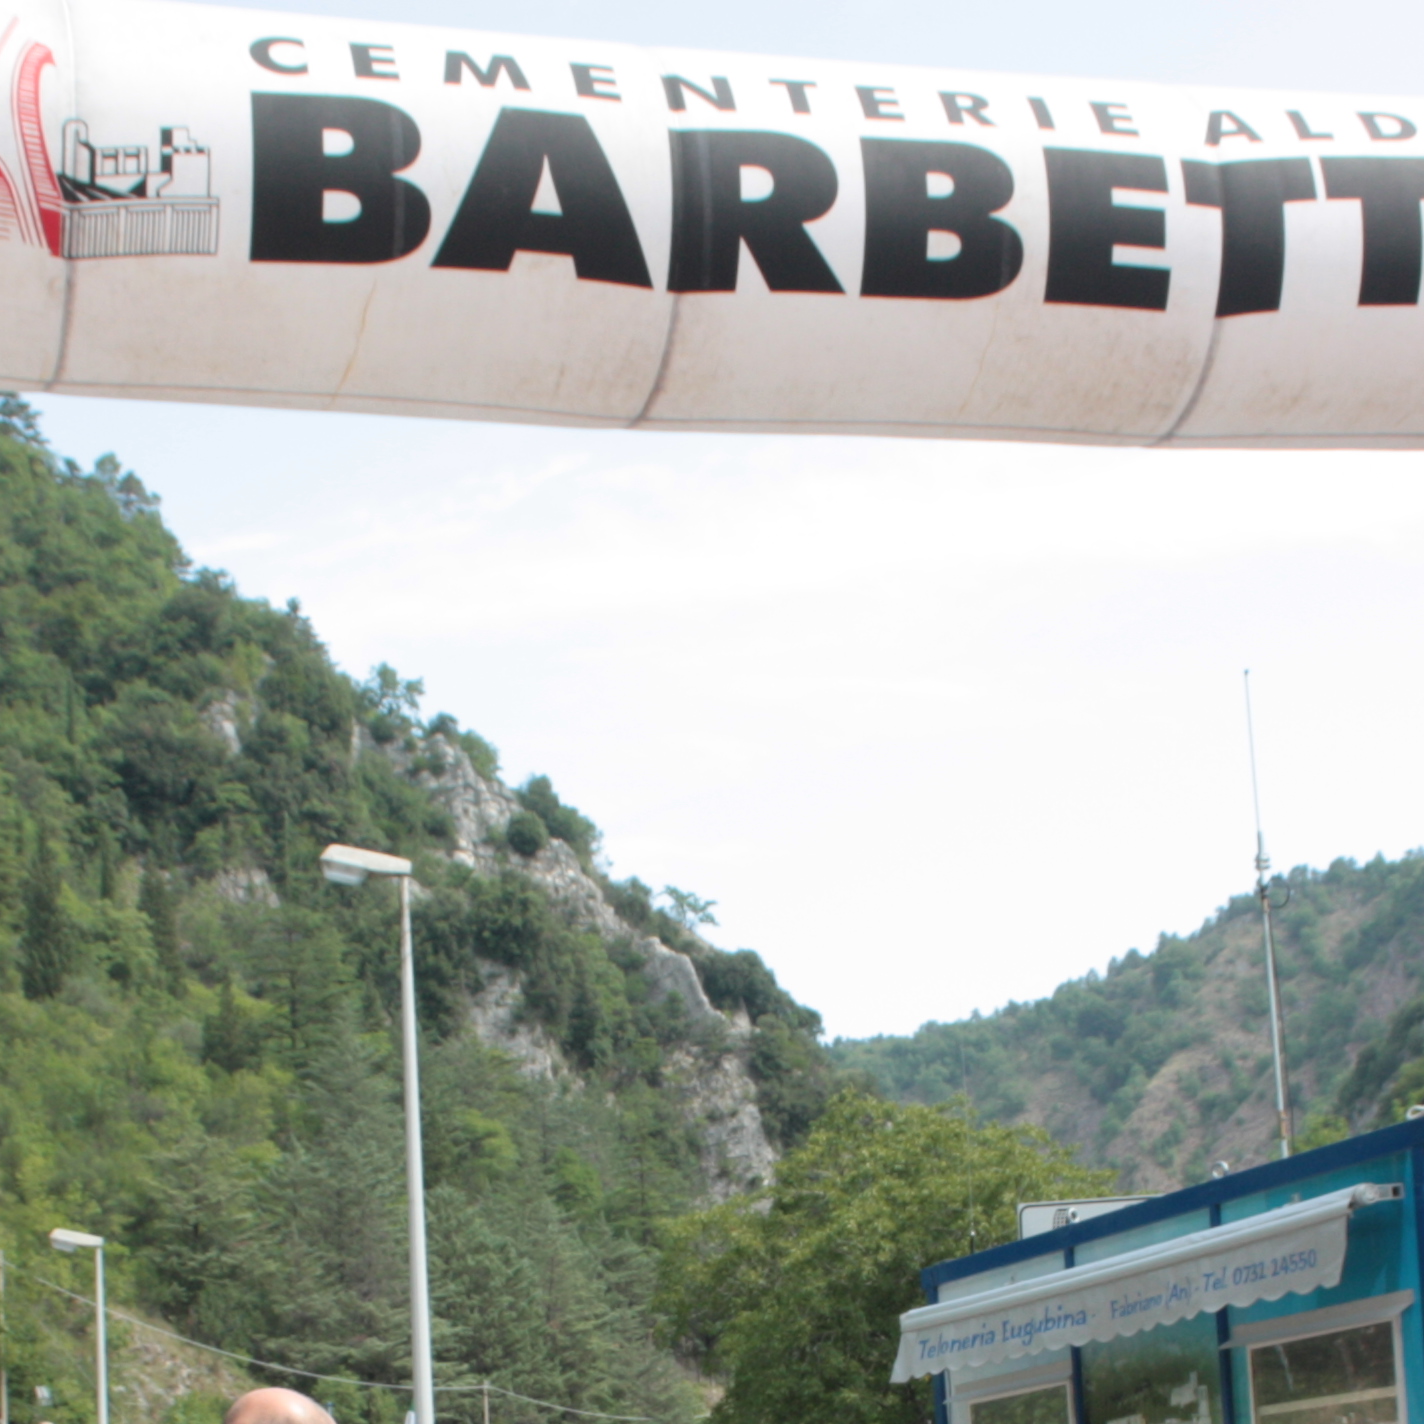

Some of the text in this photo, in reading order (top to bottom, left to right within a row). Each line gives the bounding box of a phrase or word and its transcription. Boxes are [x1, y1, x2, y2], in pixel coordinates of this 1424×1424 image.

[249, 36, 1139, 137] CEMENTERIE
[919, 1323, 996, 1360] Teloneria
[1002, 1305, 1087, 1346] Eugubina
[1110, 1291, 1163, 1319] Fabriano
